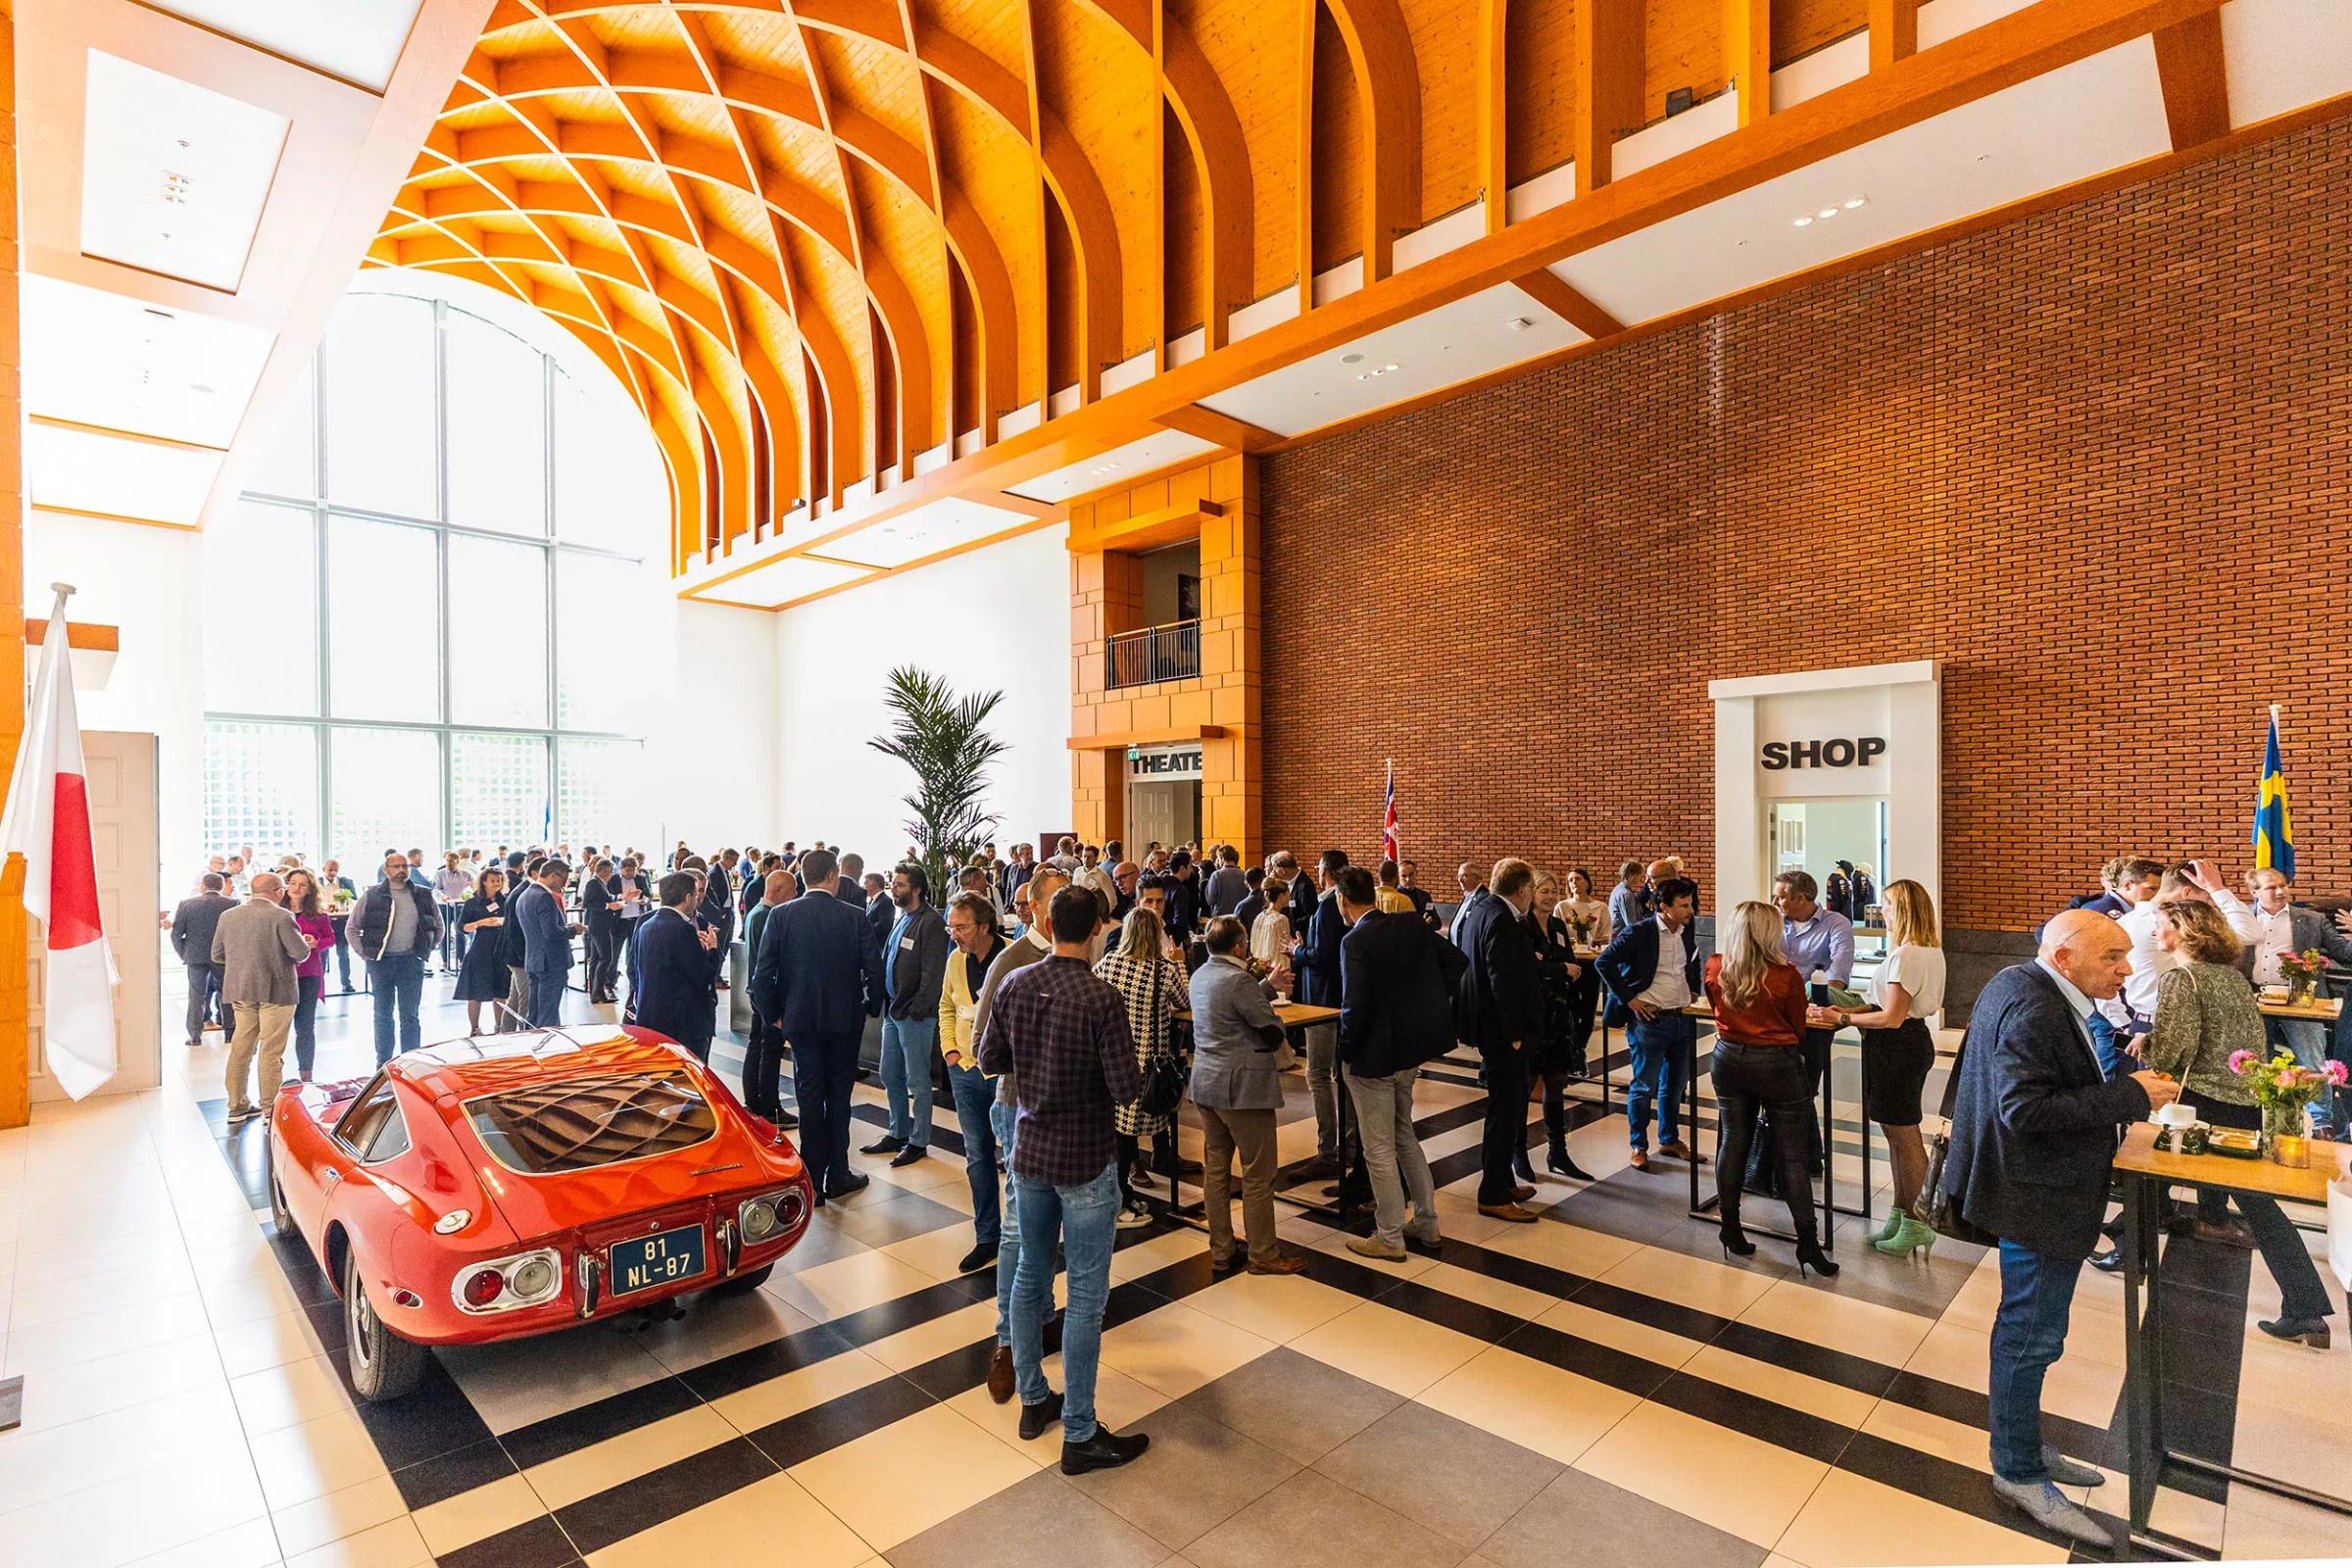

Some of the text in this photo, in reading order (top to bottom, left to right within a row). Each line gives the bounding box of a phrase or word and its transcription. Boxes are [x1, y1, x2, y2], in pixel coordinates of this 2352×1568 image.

[1761, 737, 1886, 769] SHOP
[645, 1238, 665, 1260] 81
[628, 1252, 690, 1288] NL-87
